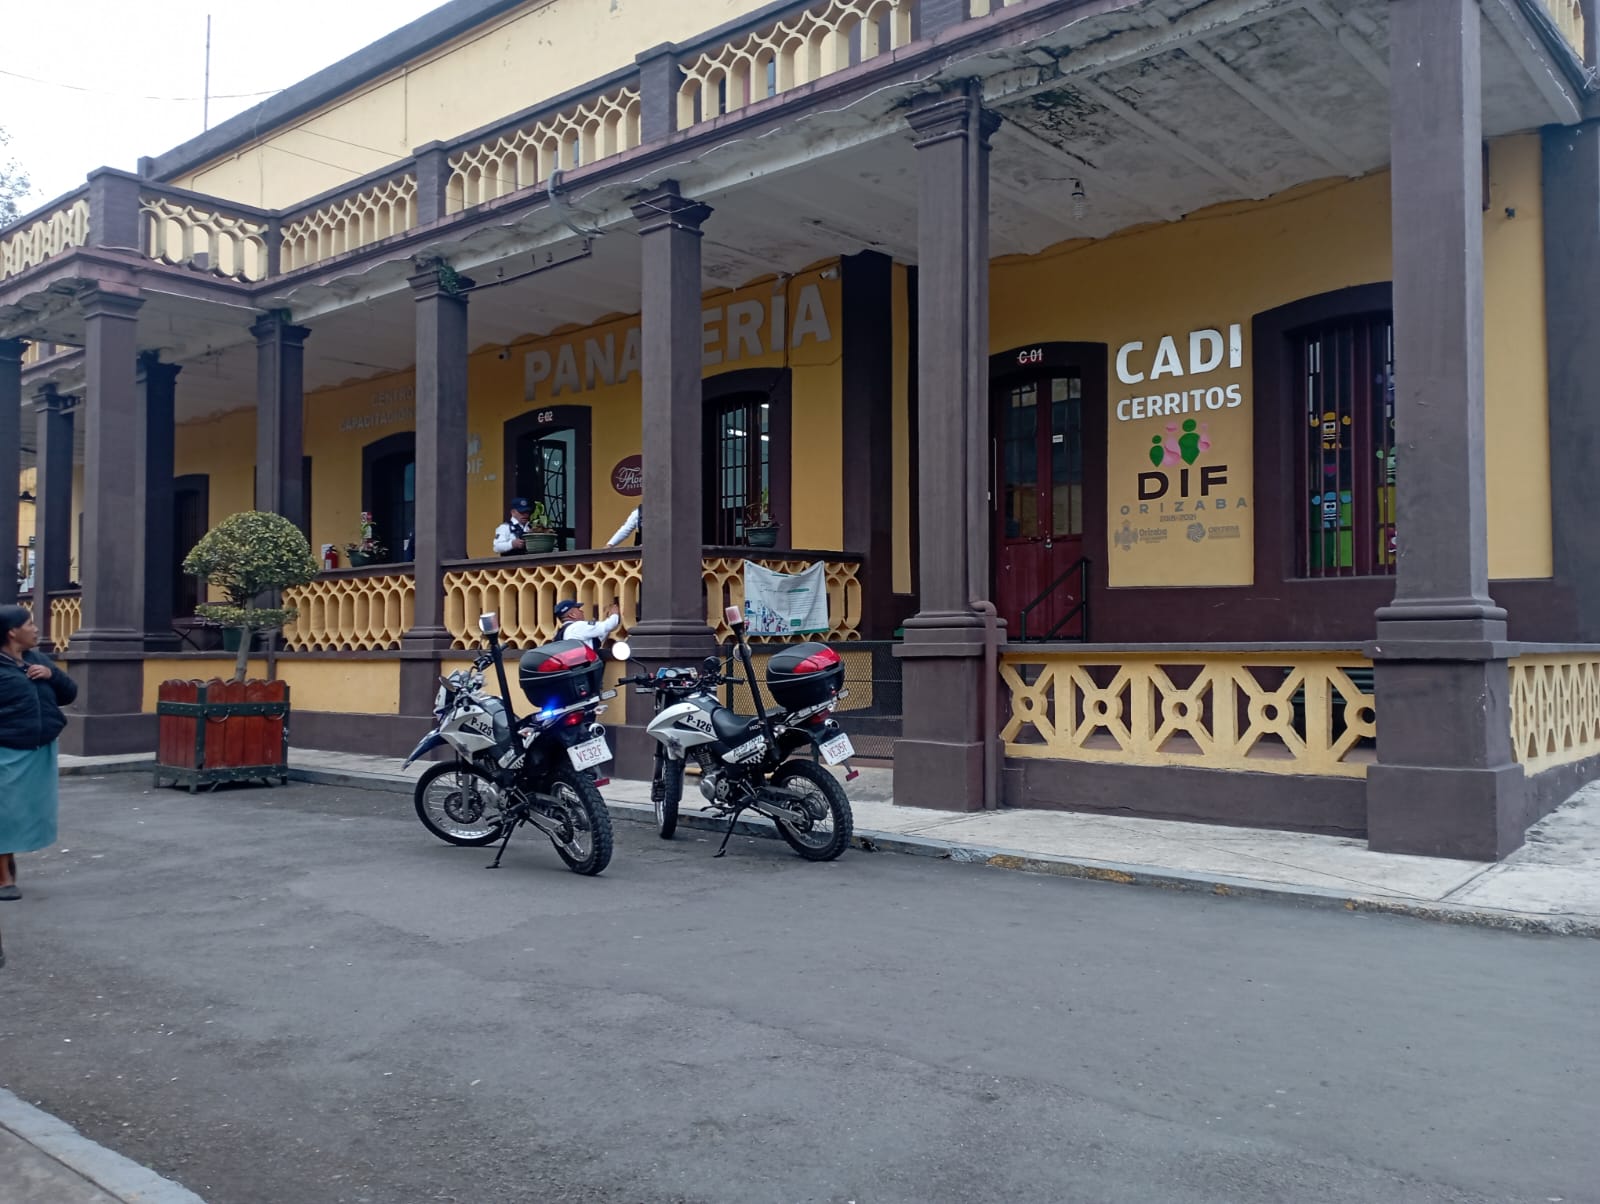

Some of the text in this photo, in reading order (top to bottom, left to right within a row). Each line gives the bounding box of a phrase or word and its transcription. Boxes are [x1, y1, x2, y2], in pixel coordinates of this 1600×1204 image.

[524, 283, 832, 401] PANAERÍA
[1116, 323, 1243, 384] CADI
[1116, 383, 1242, 421] CERRITOS
[1137, 464, 1228, 500] DIF
[1120, 497, 1248, 515] ORIZABA
[470, 716, 493, 737] P-125
[686, 714, 713, 733] P-126
[576, 744, 602, 763] VE32F
